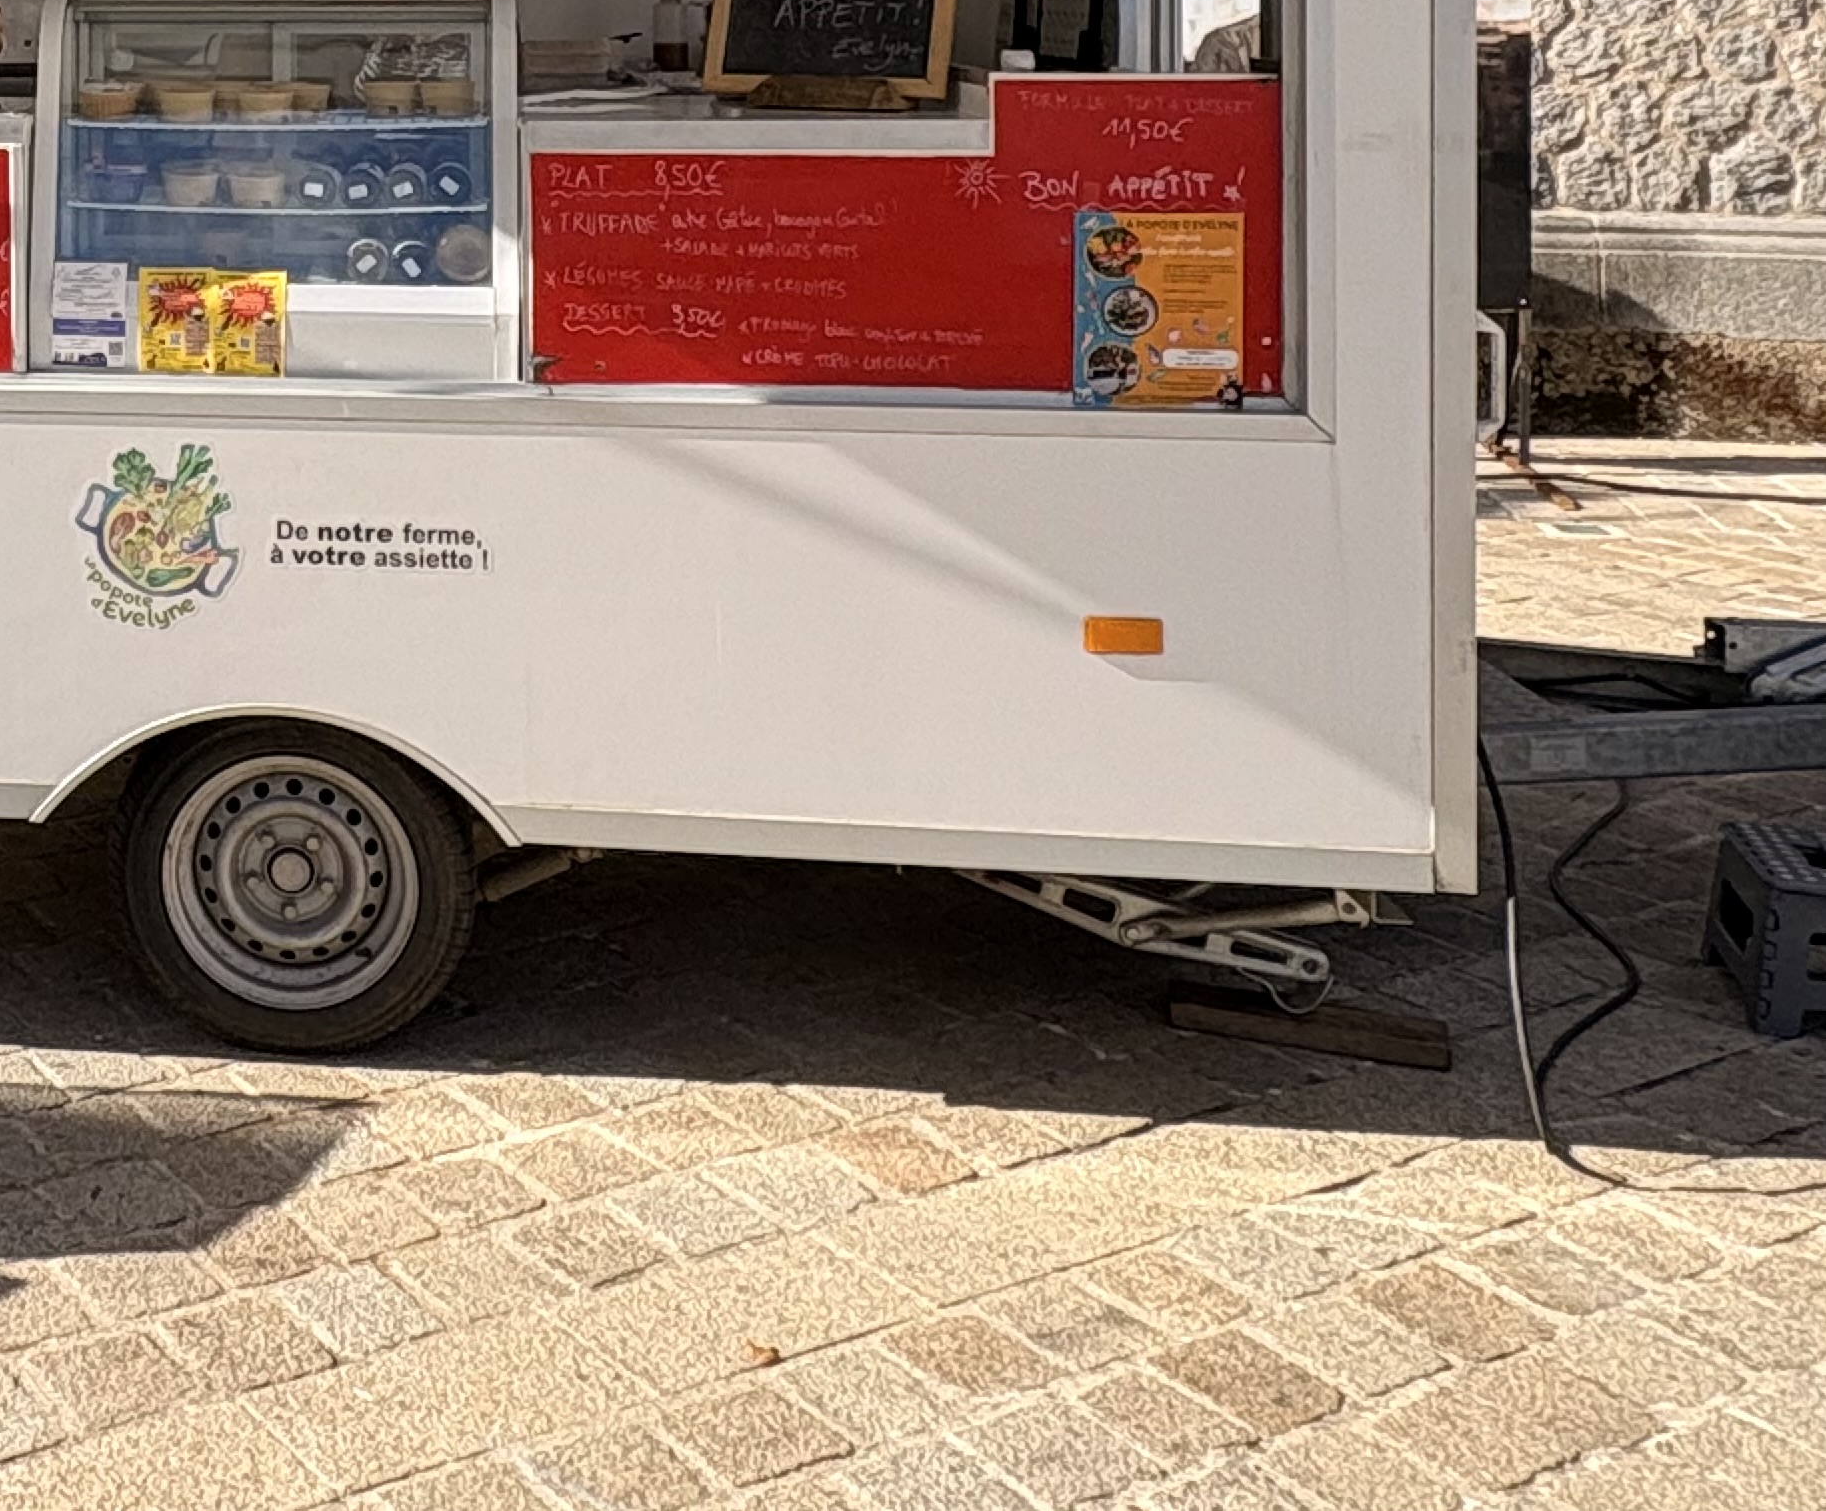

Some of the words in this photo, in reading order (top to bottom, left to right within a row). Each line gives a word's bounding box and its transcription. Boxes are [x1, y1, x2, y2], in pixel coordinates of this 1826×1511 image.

[1103, 116, 1194, 150] 11,50€
[549, 163, 613, 188] PLAT
[1019, 170, 1079, 201] BON
[559, 212, 659, 236] TRUFFADE
[277, 520, 309, 542] De
[318, 522, 394, 543] notre
[402, 522, 484, 549] ferme,
[271, 543, 284, 565] à
[293, 547, 366, 567] votre
[374, 546, 473, 571] assiette
